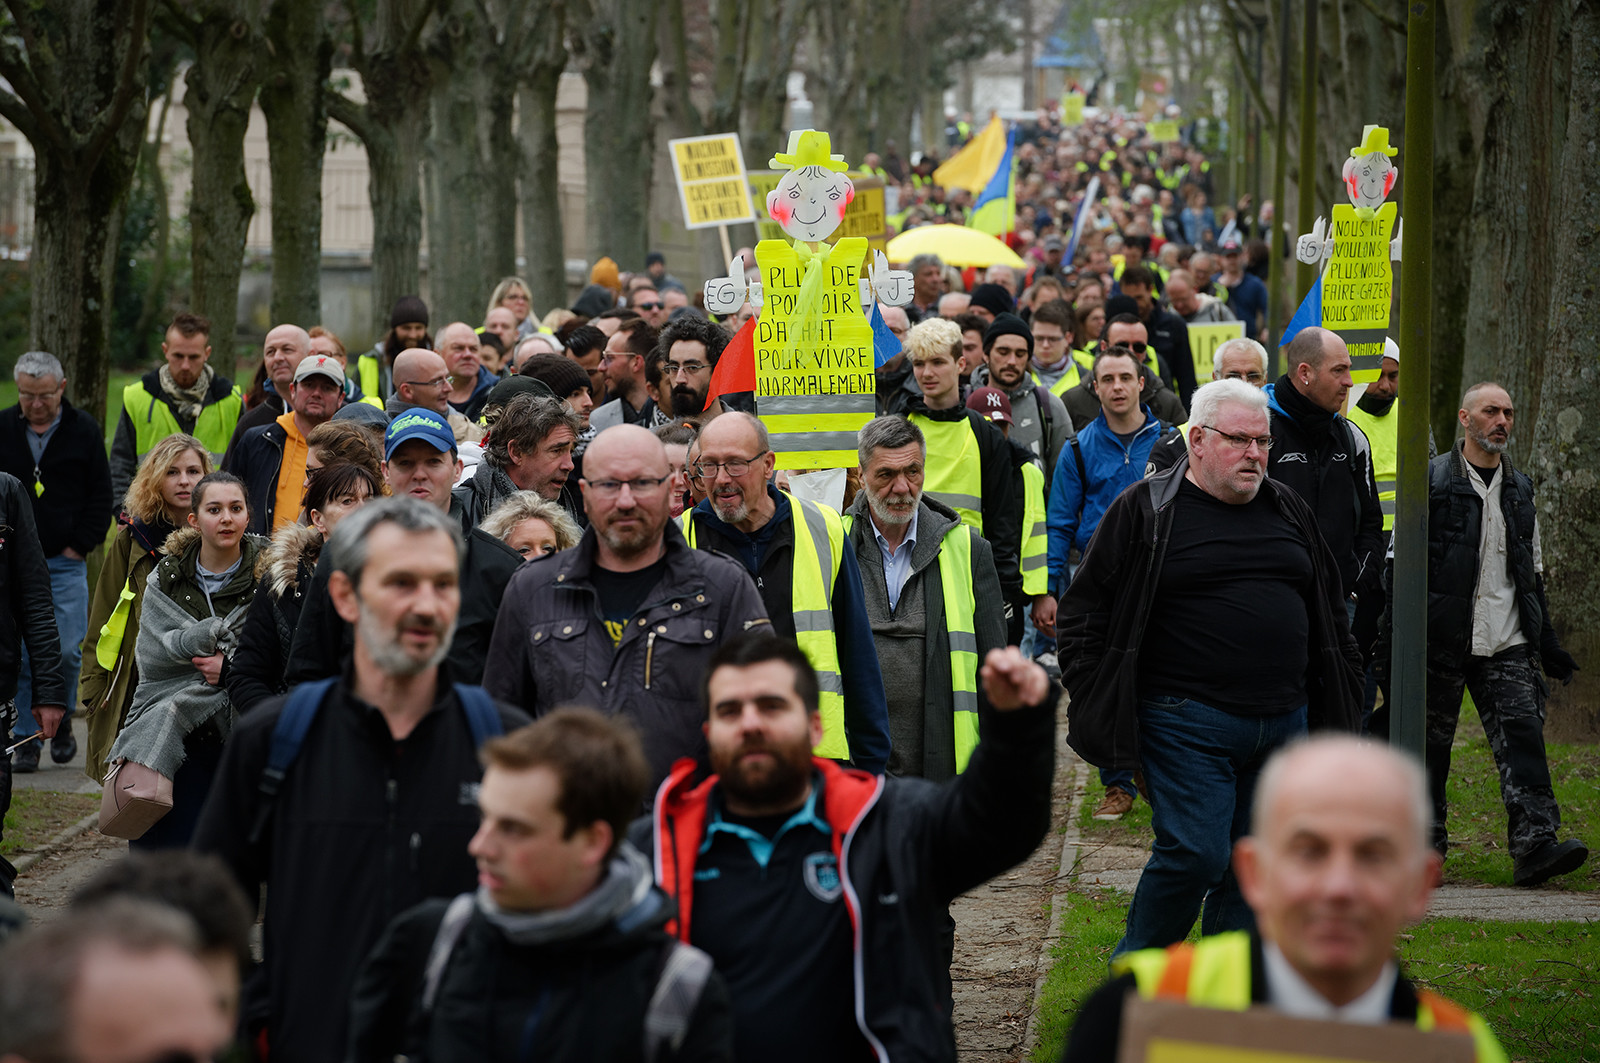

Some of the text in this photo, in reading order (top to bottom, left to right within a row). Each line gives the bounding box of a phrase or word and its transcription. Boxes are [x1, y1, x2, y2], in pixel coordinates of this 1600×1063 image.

[1336, 219, 1385, 237] NOUS NE
[1335, 241, 1383, 258] VOULONS
[769, 265, 856, 288] PLU DE
[1330, 261, 1386, 279] PLUS NOUS
[717, 283, 736, 304] G
[887, 276, 905, 301] J
[1323, 280, 1391, 300] FAIRE GAZER
[1322, 303, 1386, 322] NOUS SOMMES
[758, 344, 869, 371] POUR VIVRE
[758, 372, 875, 396] NORMALEMENT
